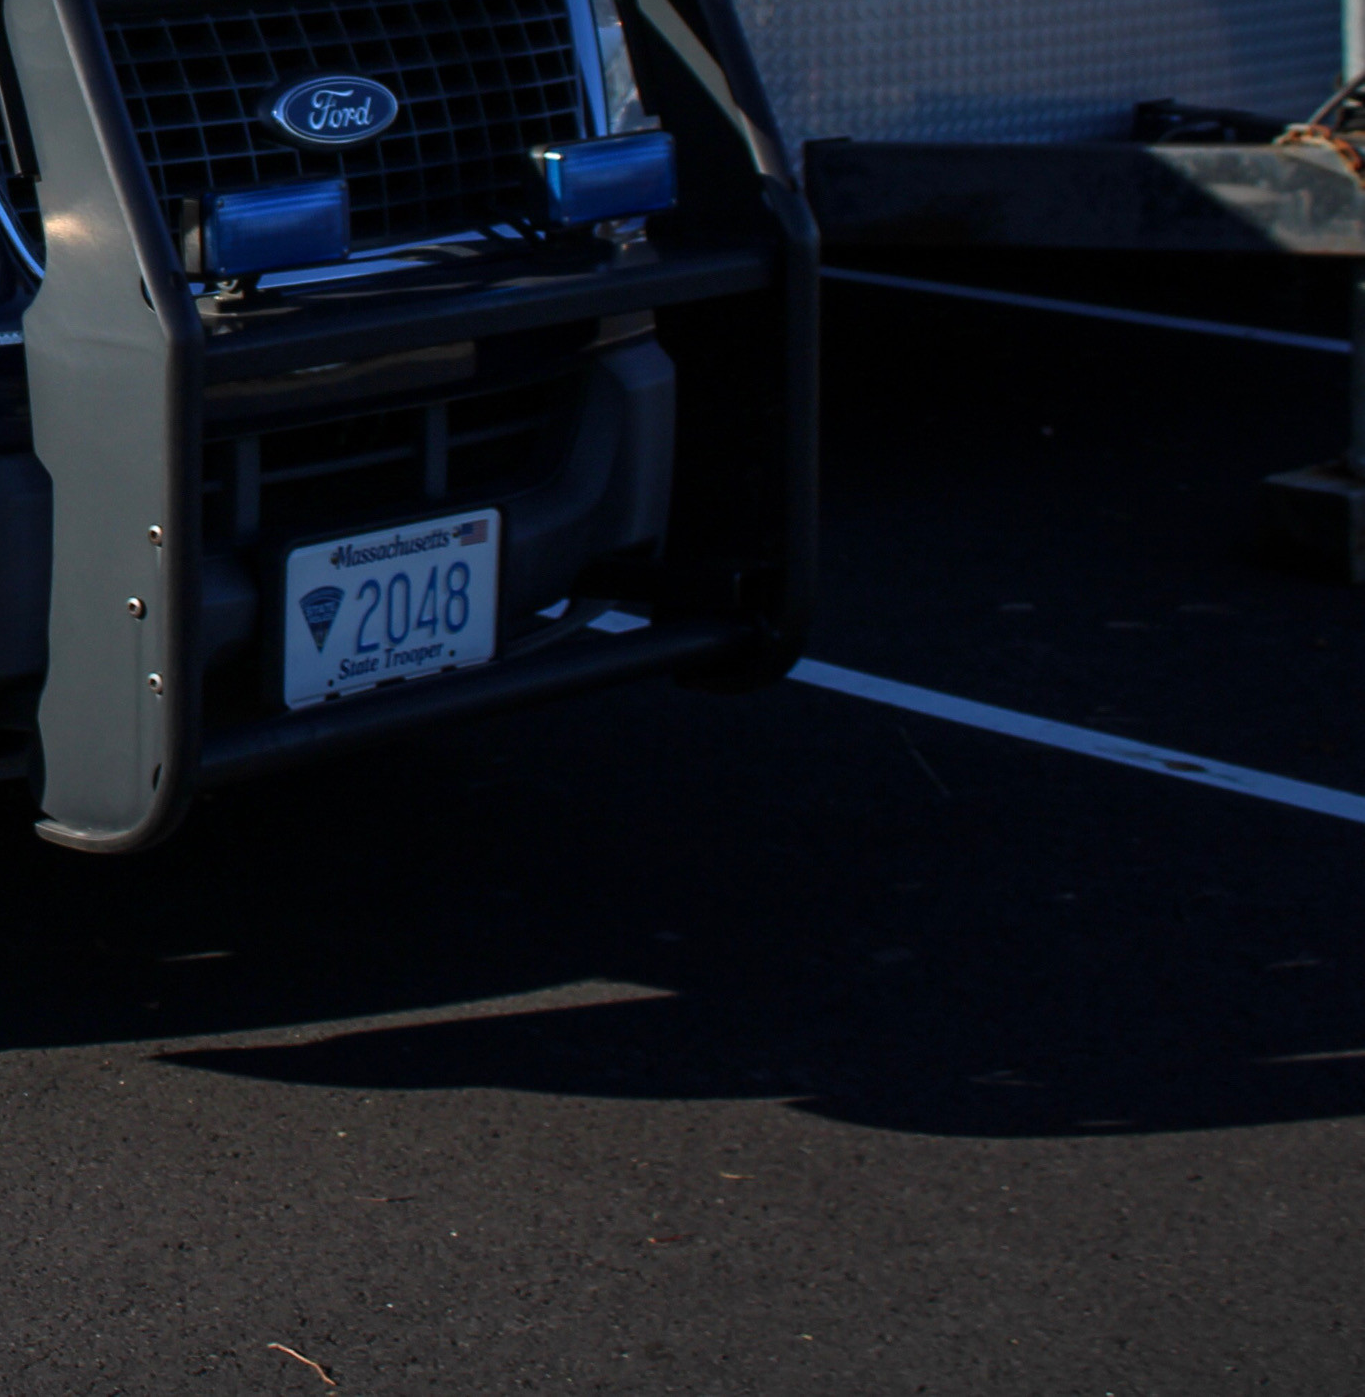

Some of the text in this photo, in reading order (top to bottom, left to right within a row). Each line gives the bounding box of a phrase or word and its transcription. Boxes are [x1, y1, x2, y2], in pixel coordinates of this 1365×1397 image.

[309, 89, 374, 131] Ford
[336, 528, 451, 570] Massachusetts
[357, 561, 470, 654] 2048
[338, 643, 445, 680] State Trooper
